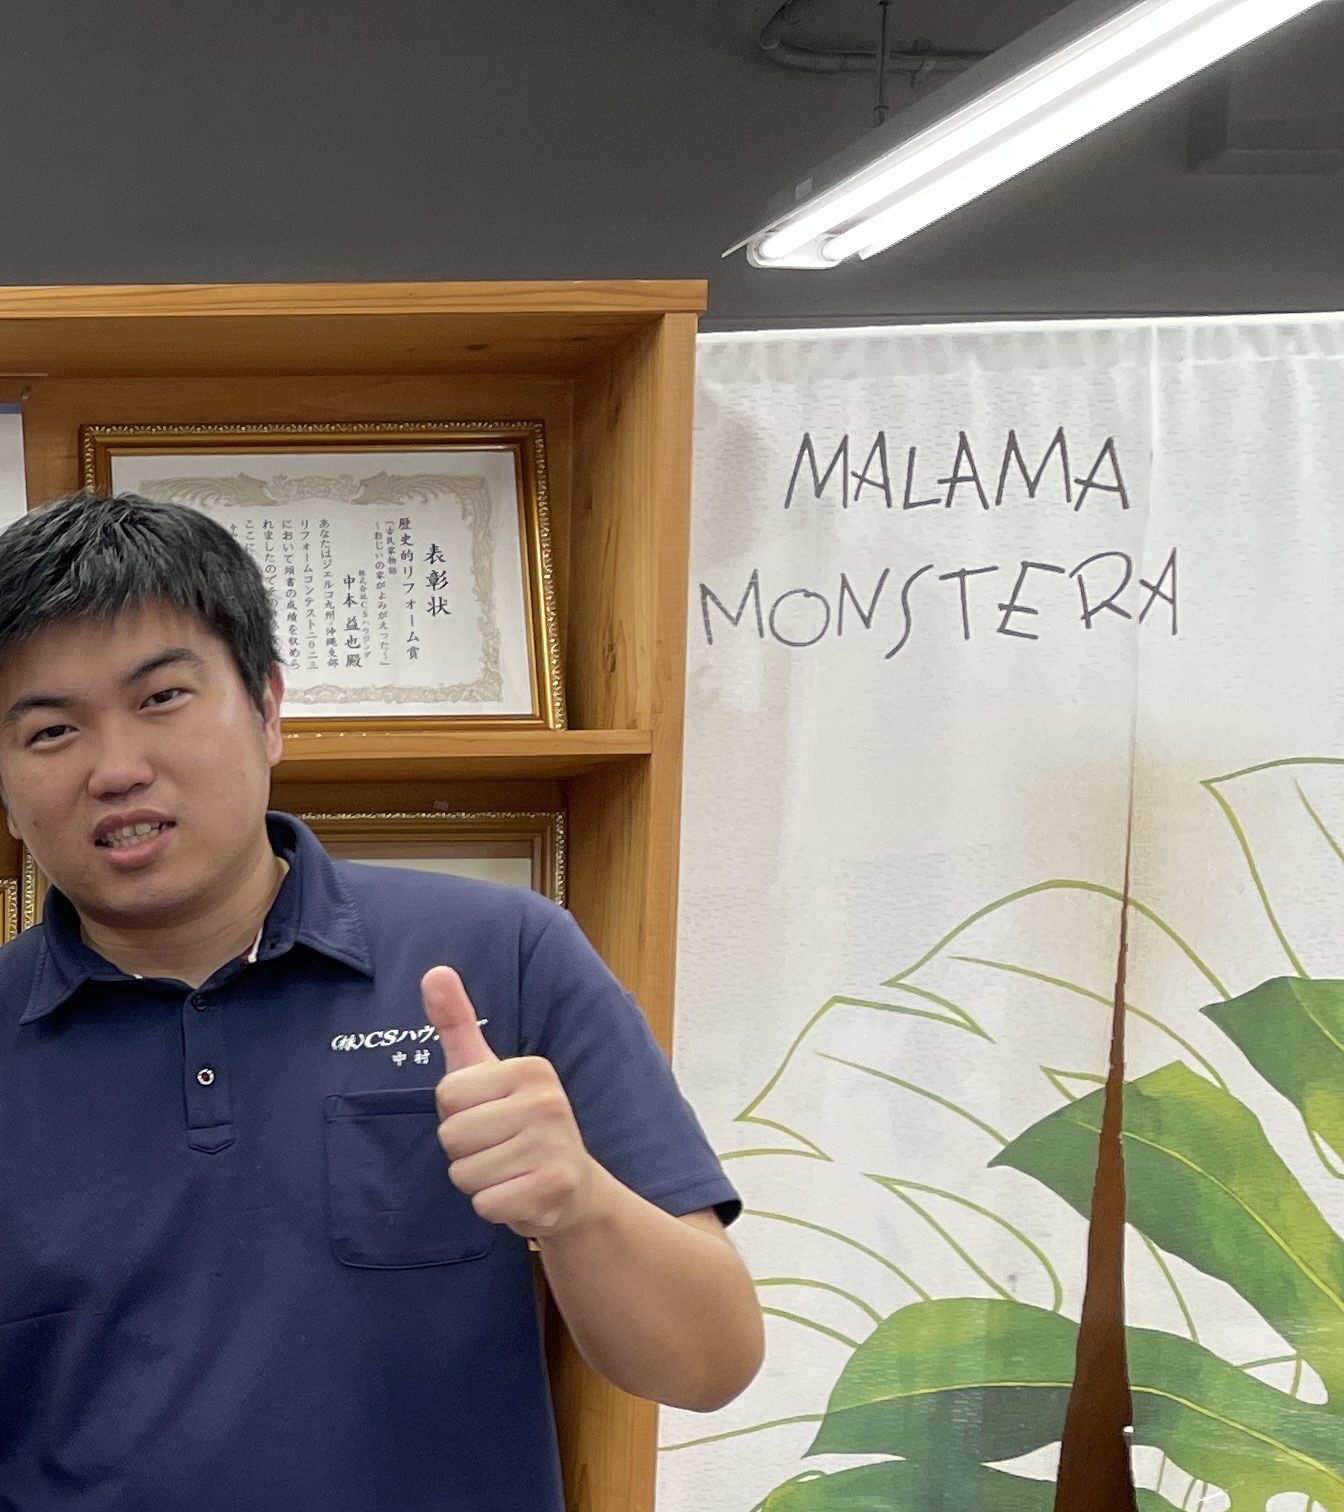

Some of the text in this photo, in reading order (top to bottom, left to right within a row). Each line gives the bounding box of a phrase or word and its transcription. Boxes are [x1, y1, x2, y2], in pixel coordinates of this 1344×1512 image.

[784, 427, 1130, 511] MALAMA
[398, 517, 420, 660] 歴史的リフォーム賞
[423, 543, 451, 617] 表彰状
[699, 547, 1178, 660] MONSTERA
[391, 1050, 431, 1067] 中村
